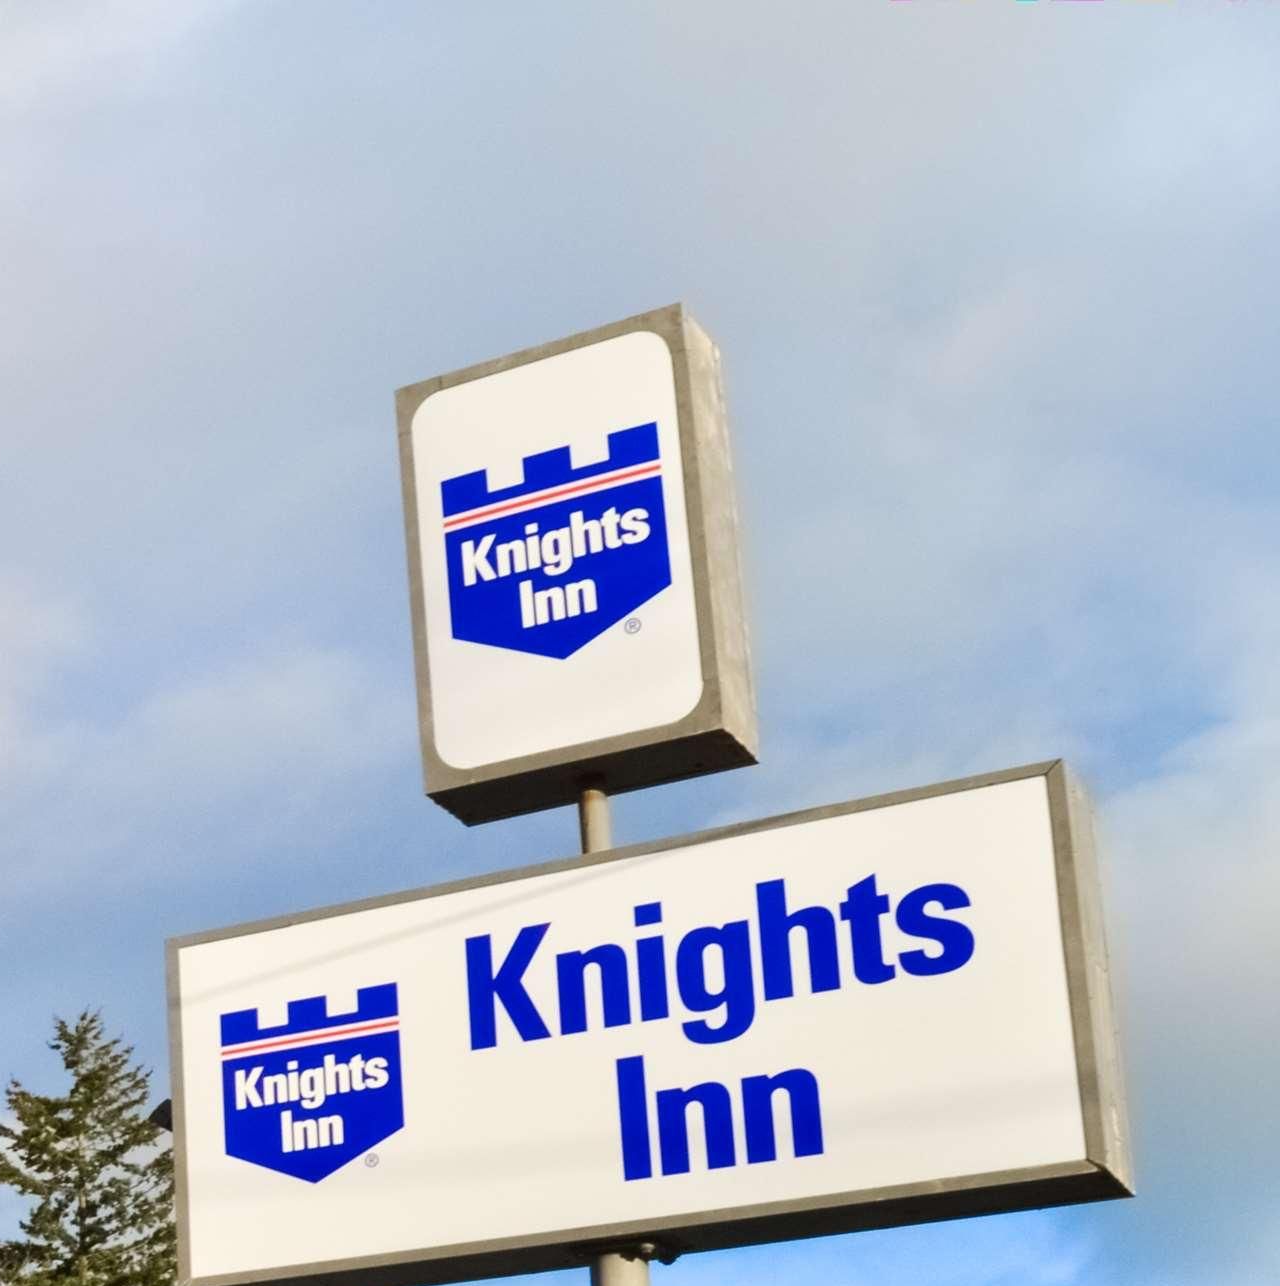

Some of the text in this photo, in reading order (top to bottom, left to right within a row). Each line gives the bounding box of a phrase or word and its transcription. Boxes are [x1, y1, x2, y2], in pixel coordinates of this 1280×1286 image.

[461, 506, 651, 587] Knights
[519, 578, 598, 629] Inn
[465, 874, 975, 1050] Knights
[234, 1053, 389, 1111] Knights
[280, 1109, 344, 1153] Inn
[616, 1055, 824, 1181] Inn
